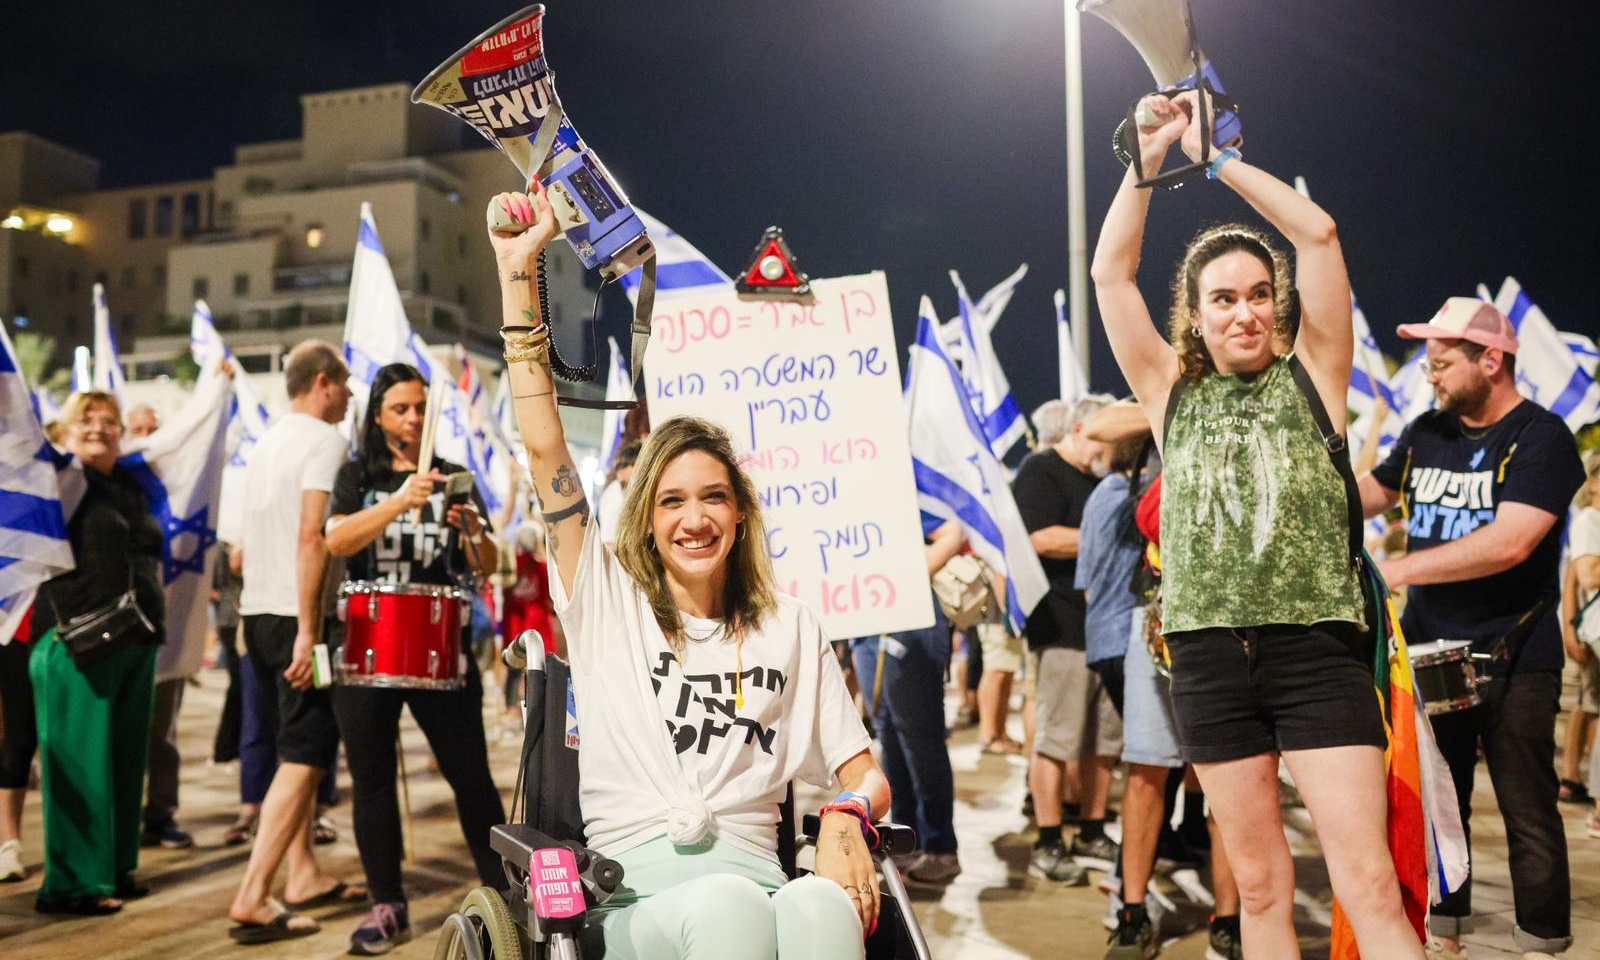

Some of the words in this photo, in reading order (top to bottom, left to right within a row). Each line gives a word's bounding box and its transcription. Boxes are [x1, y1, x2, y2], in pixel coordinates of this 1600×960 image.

[473, 67, 527, 97] למגילת
[478, 77, 551, 129] נאמ
[841, 290, 876, 333] בן
[720, 353, 836, 392] המשטרה
[848, 346, 888, 376] שר
[657, 373, 706, 399] הוא
[748, 390, 831, 449] עבריין
[822, 437, 877, 465] הוא
[759, 476, 837, 507] ופירומ
[1410, 467, 1494, 509] חופשי
[814, 522, 884, 575] תומך
[821, 573, 896, 616] הוא
